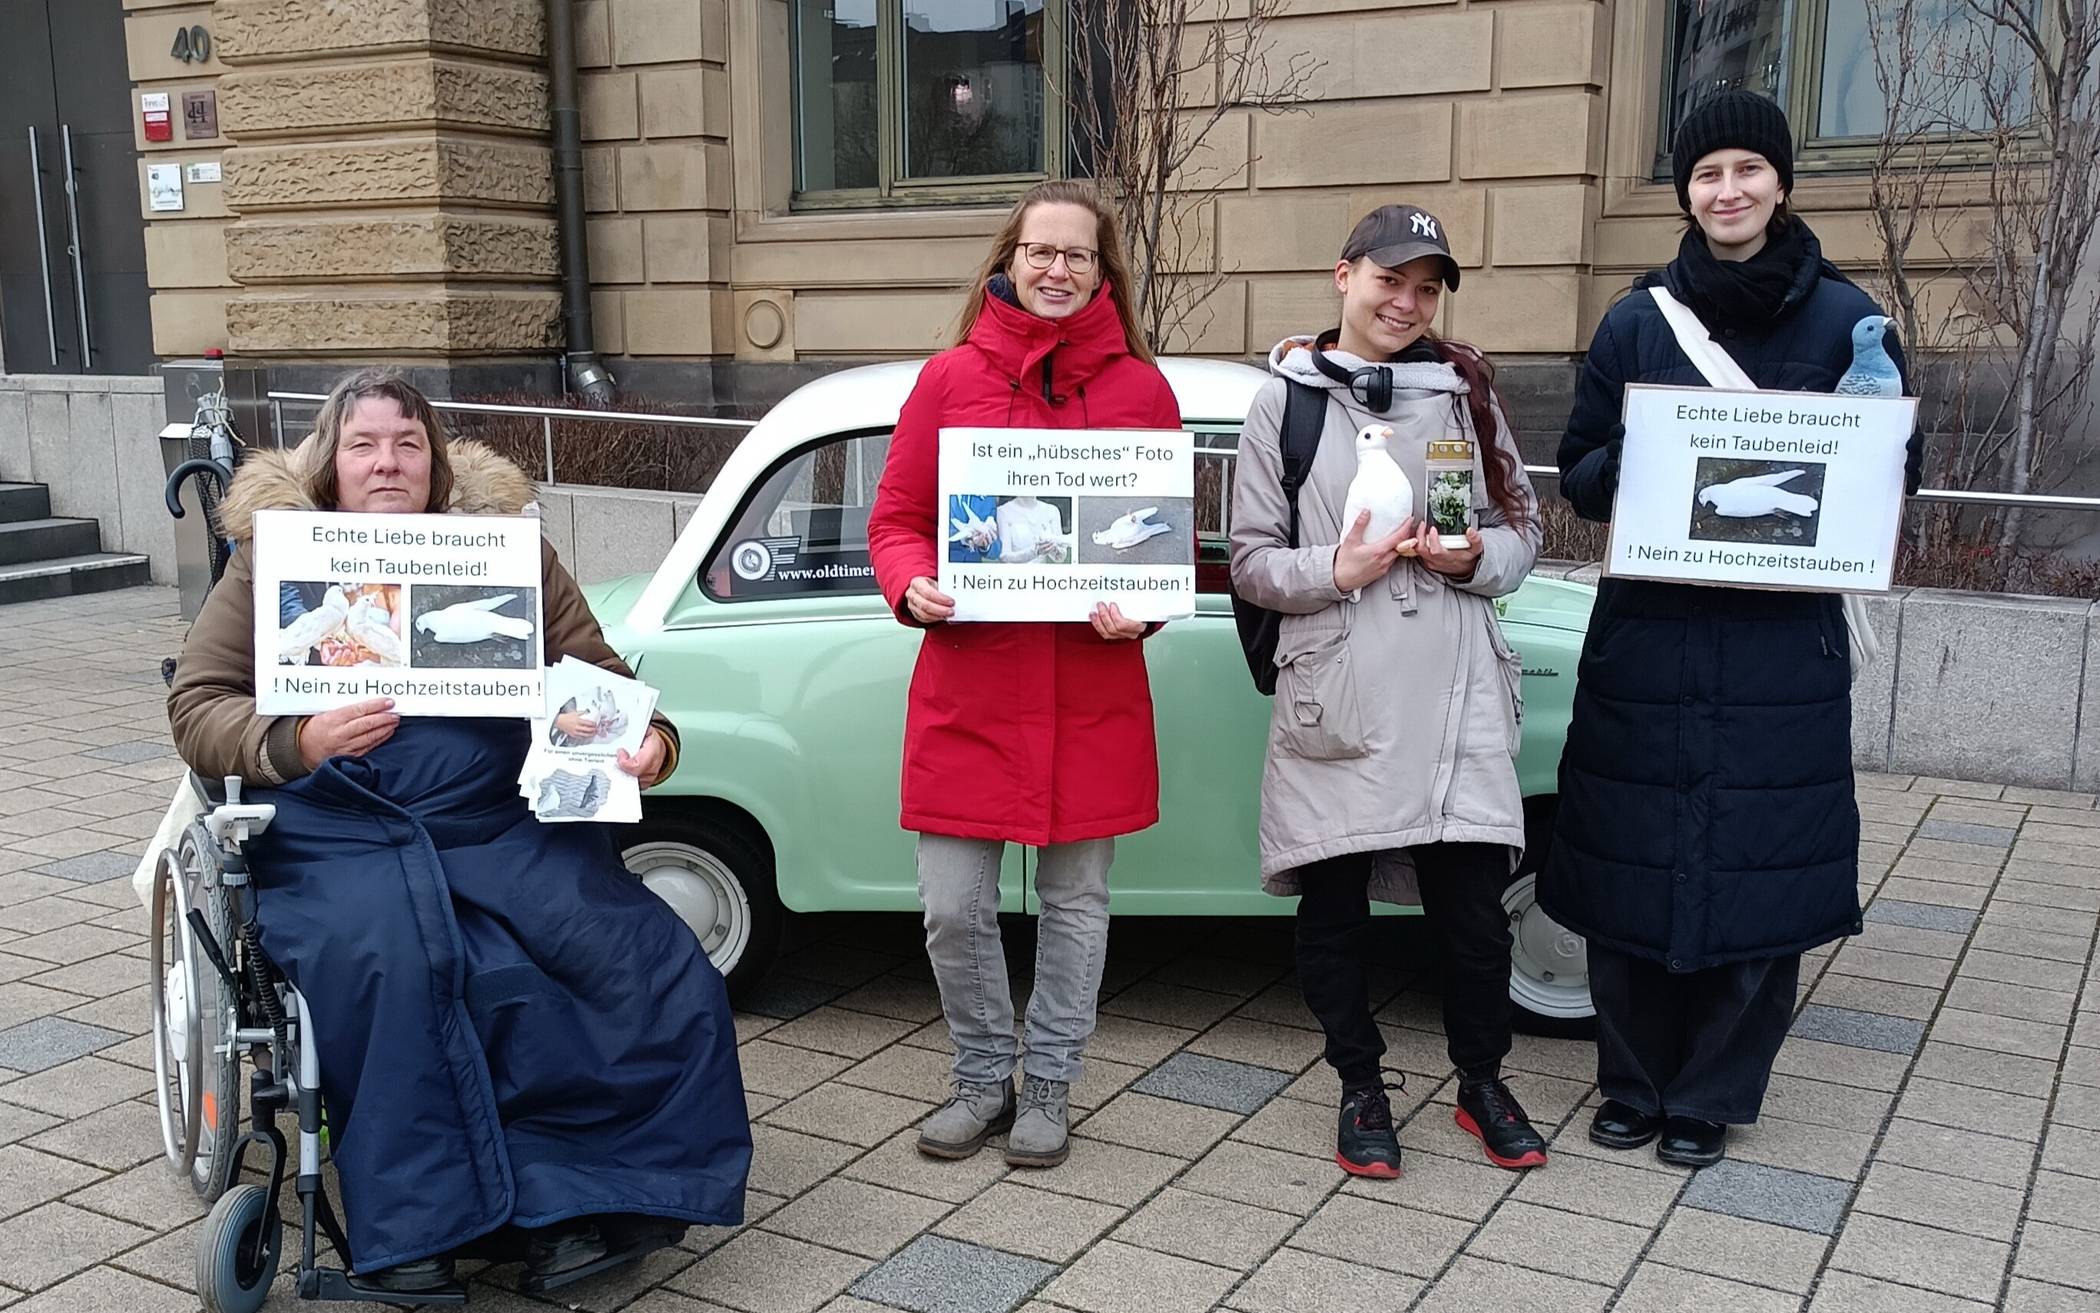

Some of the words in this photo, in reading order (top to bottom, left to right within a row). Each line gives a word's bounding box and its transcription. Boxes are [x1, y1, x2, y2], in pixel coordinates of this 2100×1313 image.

[170, 25, 210, 64] 40
[1409, 212, 1438, 240] NY
[1676, 404, 1728, 422] Echte
[1733, 407, 1783, 425] Liebe
[1788, 409, 1861, 428] braucht
[972, 442, 993, 458] Ist
[997, 443, 1023, 459] ein
[1028, 444, 1129, 461] „hübsches“
[1135, 445, 1174, 461] Foto
[1690, 433, 1727, 449] kein
[1732, 435, 1839, 455] Taubenleid!
[1007, 470, 1050, 487] ihren
[1055, 471, 1085, 487] Tod
[1089, 472, 1138, 488] wert?
[312, 526, 368, 544] Echte
[374, 528, 426, 546] Liebe
[432, 530, 505, 548] braucht
[330, 557, 370, 573] kein
[375, 558, 487, 577] Taubenleid!
[1637, 545, 1679, 561] Nein
[1682, 550, 1704, 563] zu
[1708, 549, 1864, 573] Hochzeitstauben
[963, 574, 1003, 590] Nein
[1007, 578, 1027, 590] zu
[1032, 575, 1180, 591] Hochzeitstauben
[285, 677, 331, 694] Nein
[337, 682, 358, 695] zu
[365, 679, 530, 697] Hochzeitstauben
